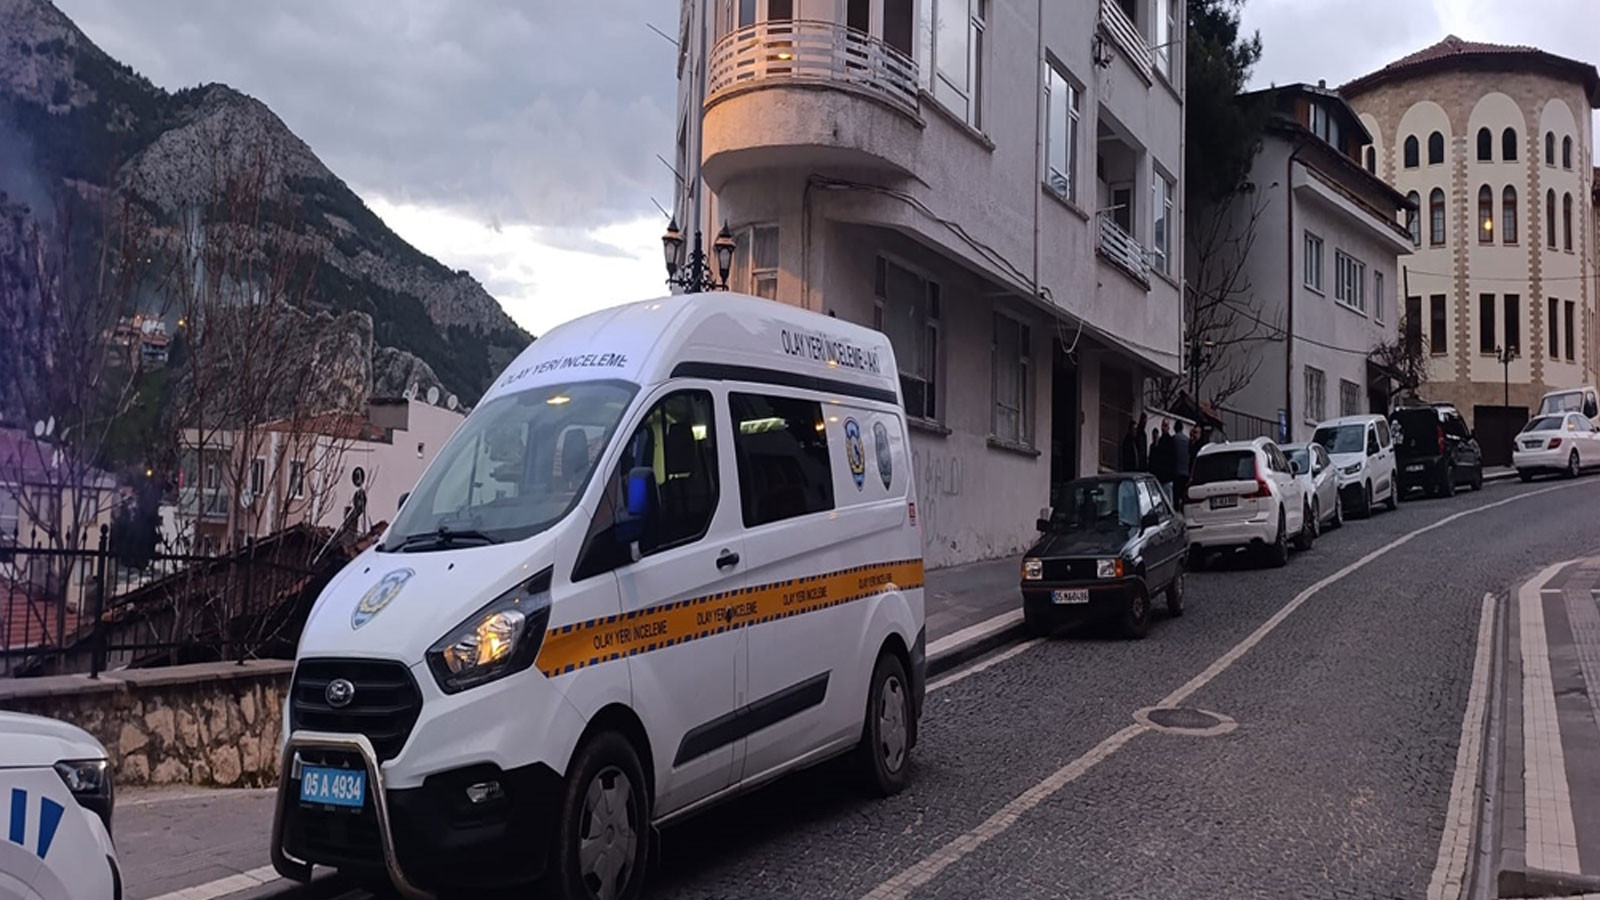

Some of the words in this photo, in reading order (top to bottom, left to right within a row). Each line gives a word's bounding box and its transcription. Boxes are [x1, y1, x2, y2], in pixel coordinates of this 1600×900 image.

[781, 329, 805, 357] OLAY
[593, 631, 614, 650] OLAY
[304, 772, 319, 796] 05
[320, 774, 329, 797] A
[331, 775, 361, 800] 4934
